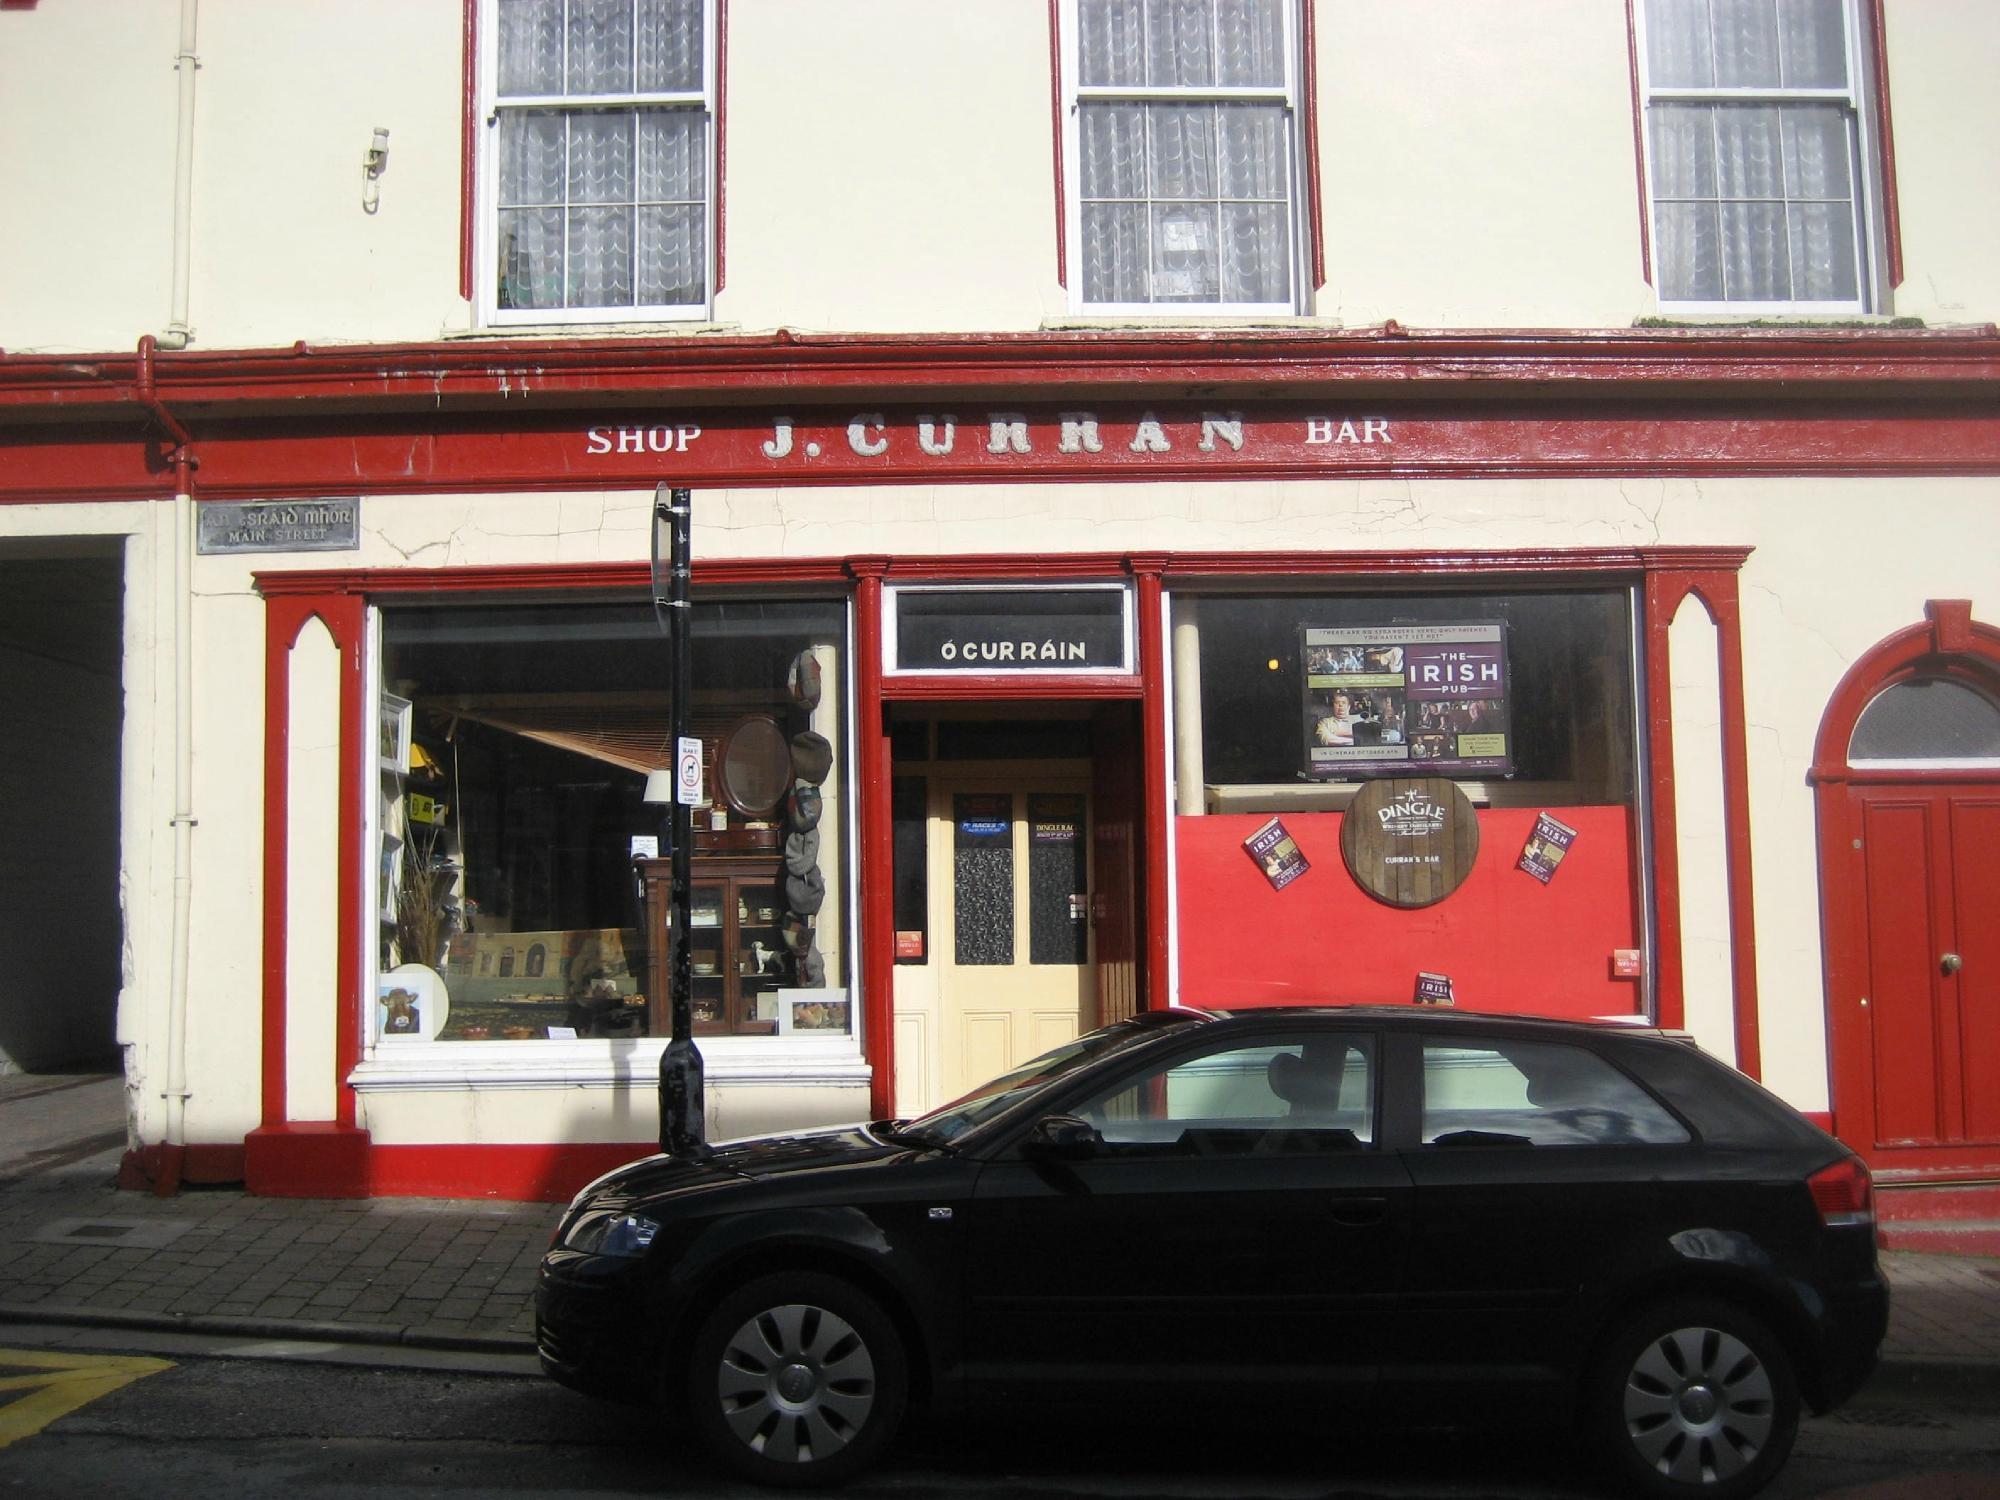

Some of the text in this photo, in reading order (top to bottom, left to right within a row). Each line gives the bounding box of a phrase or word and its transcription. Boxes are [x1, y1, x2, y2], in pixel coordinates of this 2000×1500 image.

[586, 424, 702, 455] SHOP
[846, 412, 1245, 457] CURRAN
[1304, 414, 1393, 445] BAR
[229, 528, 328, 543] MAIN STREET
[940, 639, 1086, 661] Ó CURRÁIN
[1440, 652, 1467, 661] THE
[1409, 663, 1498, 683] IRISH
[1441, 685, 1468, 694] PUB
[1377, 802, 1446, 823] DINGLE
[1253, 828, 1282, 853] IRISH
[1537, 823, 1568, 845] IRISH
